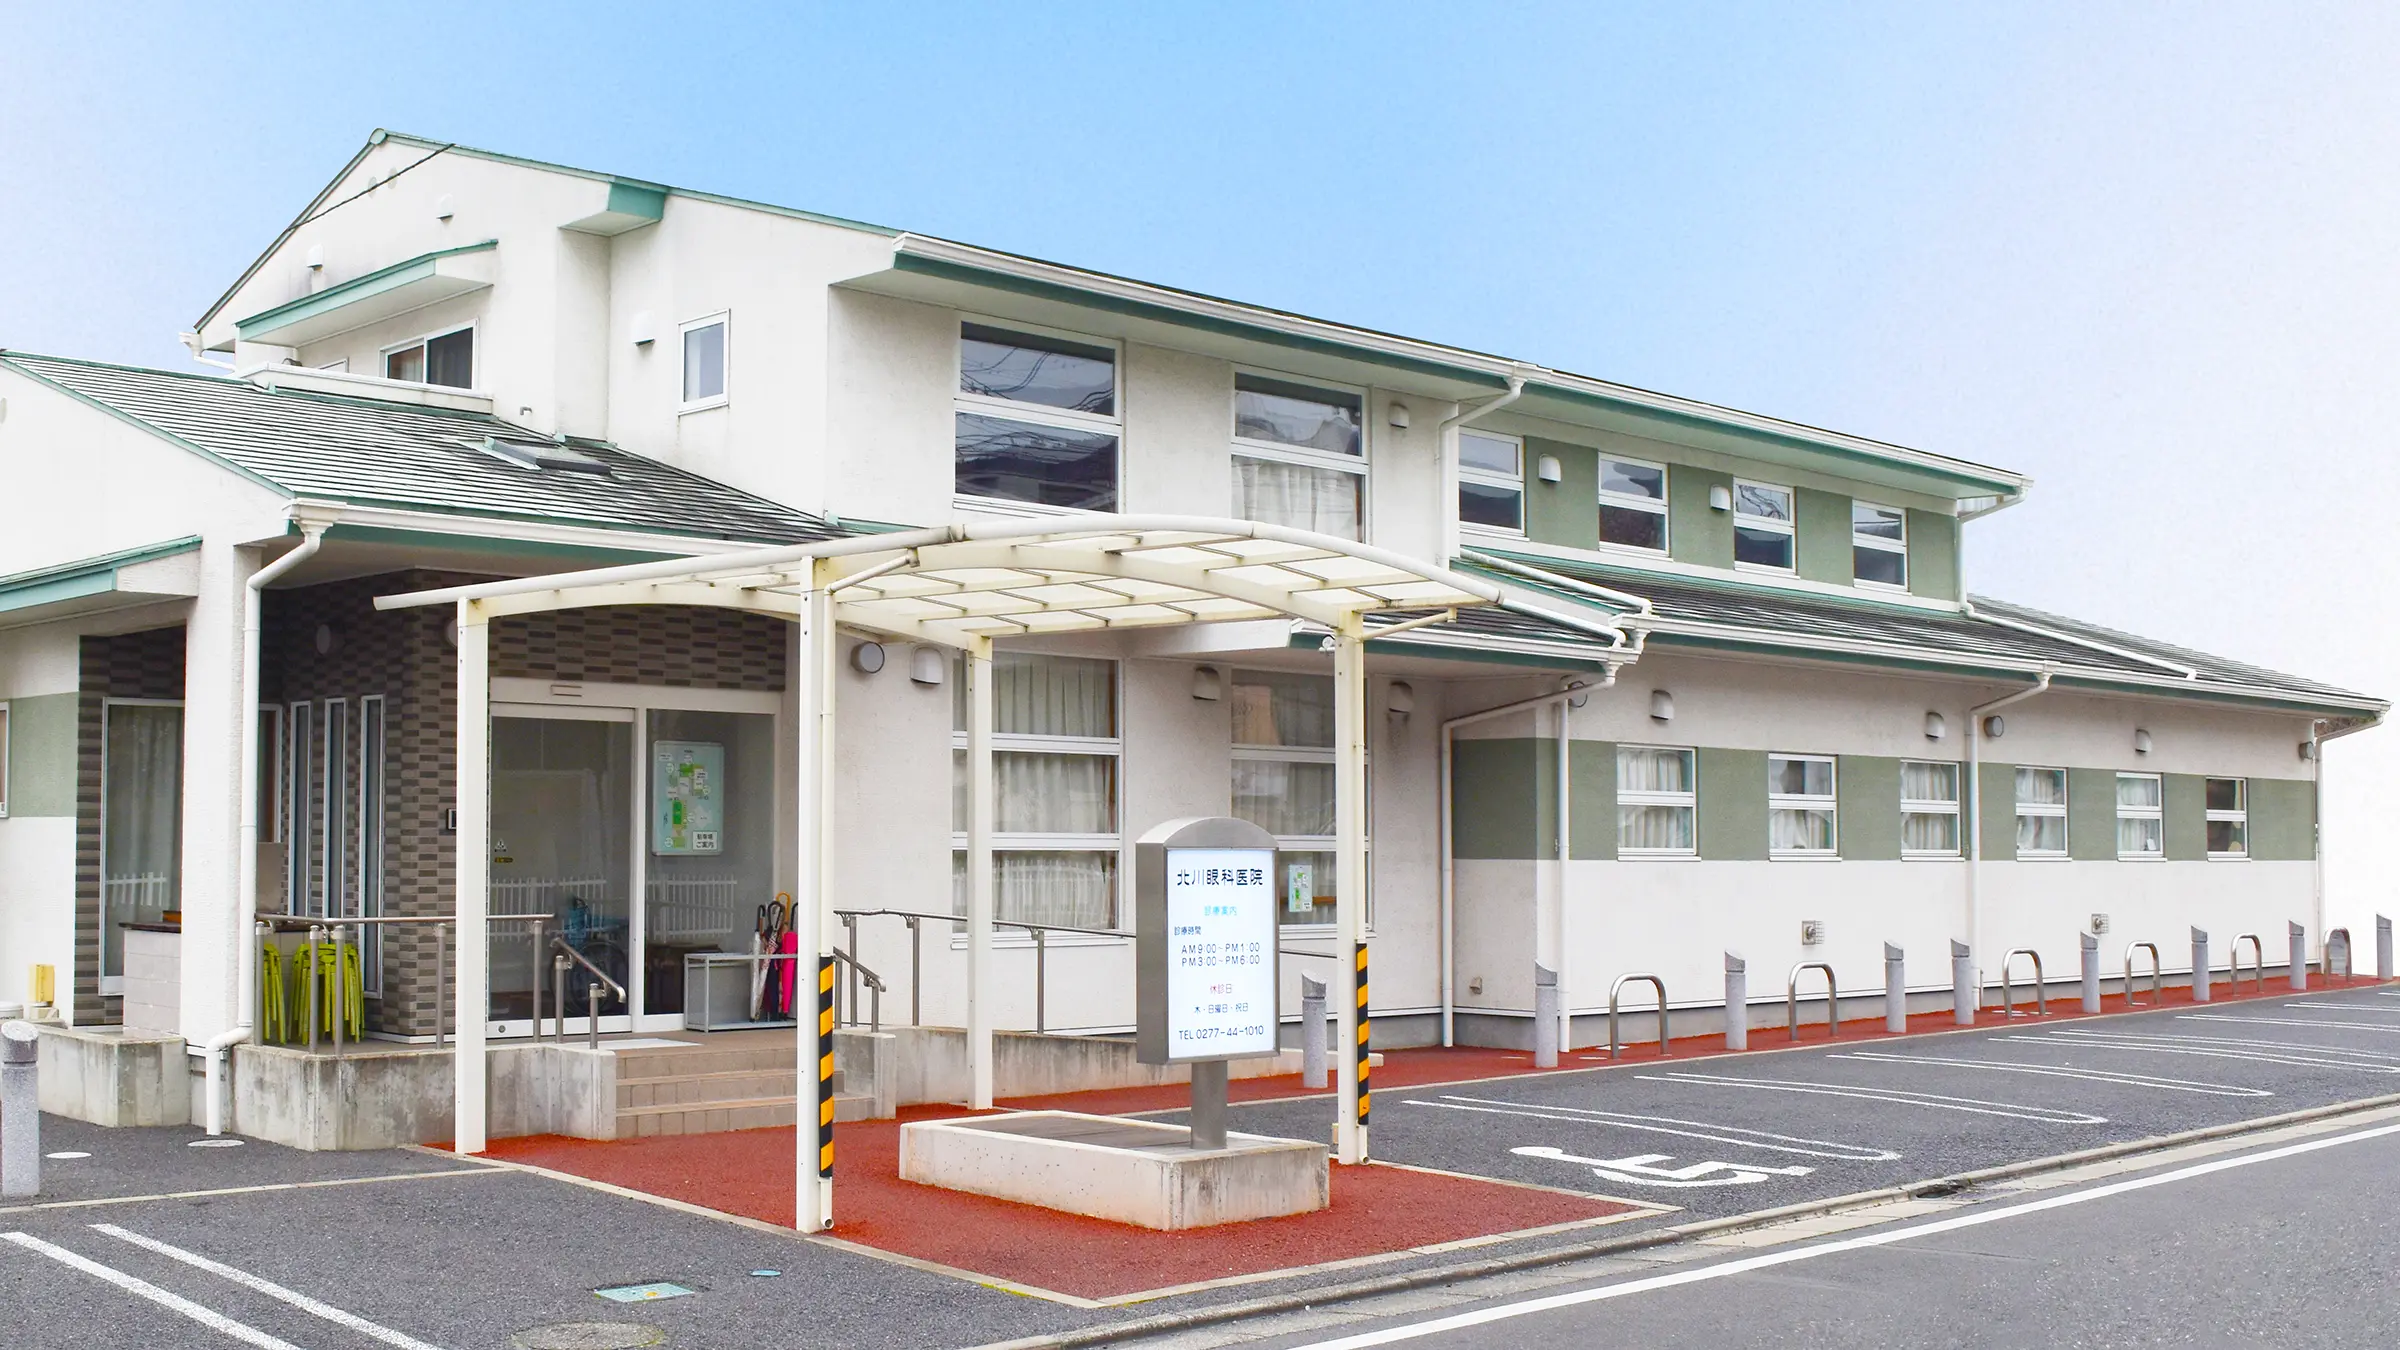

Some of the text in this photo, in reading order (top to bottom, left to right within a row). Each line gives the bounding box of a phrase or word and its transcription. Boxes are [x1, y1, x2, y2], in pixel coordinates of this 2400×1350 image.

[1177, 868, 1263, 886] 北川眼科医院
[1204, 906, 1237, 916] 診療案内
[1174, 926, 1201, 936] 診療時間
[1210, 983, 1232, 994] 休診日
[1179, 1025, 1264, 1040] TEL 0277-44-1010
